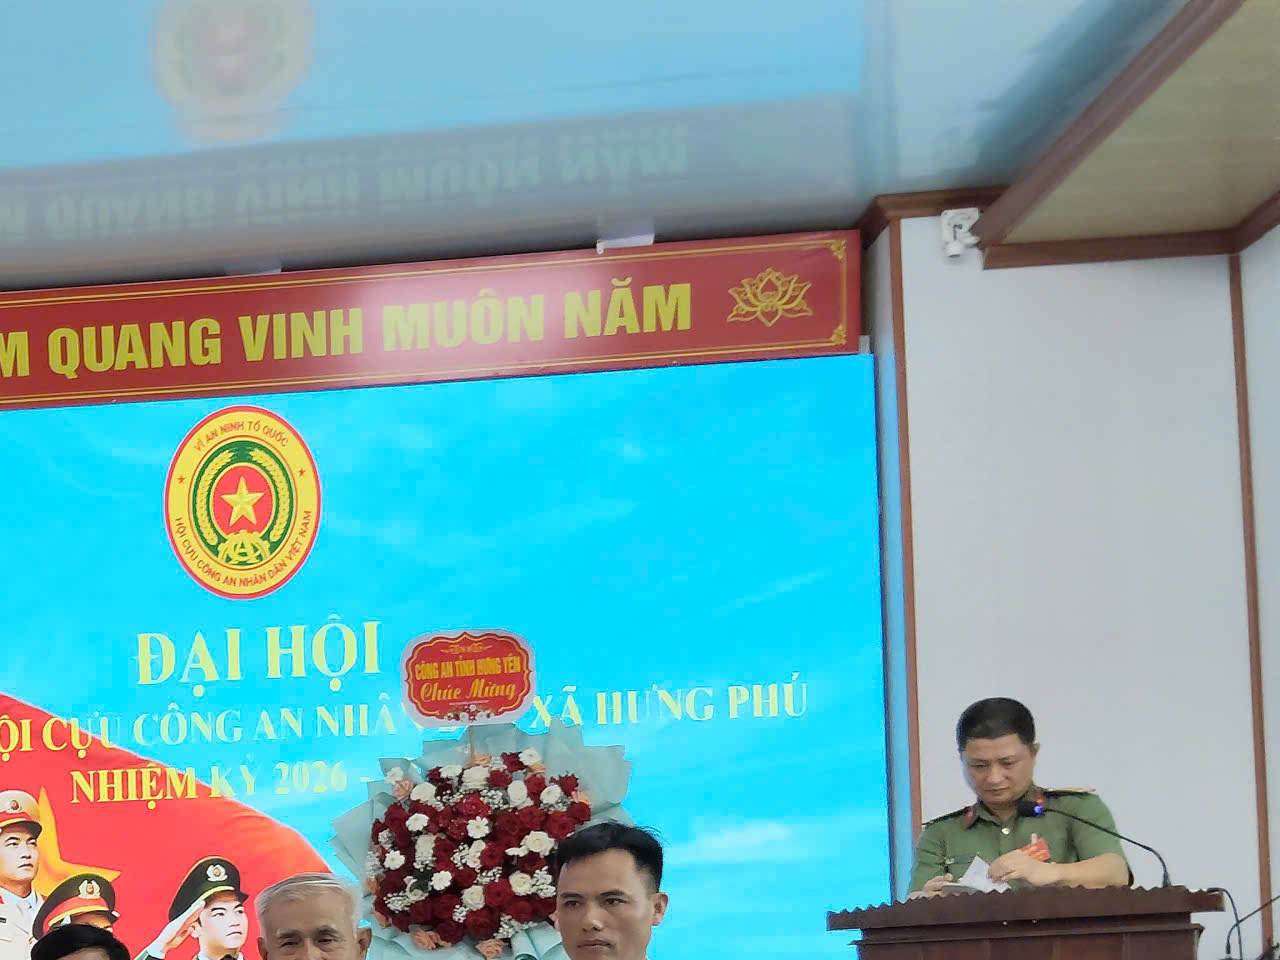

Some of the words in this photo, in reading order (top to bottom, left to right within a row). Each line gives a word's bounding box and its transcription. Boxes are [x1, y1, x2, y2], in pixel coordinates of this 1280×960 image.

[48, 318, 222, 379] QUANG
[238, 307, 364, 362] VINH
[382, 287, 545, 352] MUÔN
[564, 276, 691, 339] NĂM
[206, 428, 219, 443] AN
[220, 421, 245, 434] NINH
[262, 423, 289, 447] QUỐC
[175, 516, 186, 539] HỘI
[196, 558, 221, 583] CÔNG
[222, 576, 237, 587] AN
[239, 572, 266, 587] NHÂN
[264, 559, 287, 581] DÂN
[286, 540, 303, 562] VIỆT
[300, 510, 312, 539] NAM
[133, 629, 243, 697] ĐẠI
[265, 614, 381, 691] HỘI
[420, 681, 461, 702] Chúc
[42, 711, 121, 759] CỰU
[133, 701, 244, 746] CÔNG
[254, 706, 304, 741] AN
[316, 692, 420, 737] NHÂ
[529, 684, 583, 728] XÃ
[596, 683, 715, 726] HƯNG
[727, 671, 808, 719] PHÚ
[70, 762, 199, 810] NHIỆM
[274, 760, 349, 795] 2026
